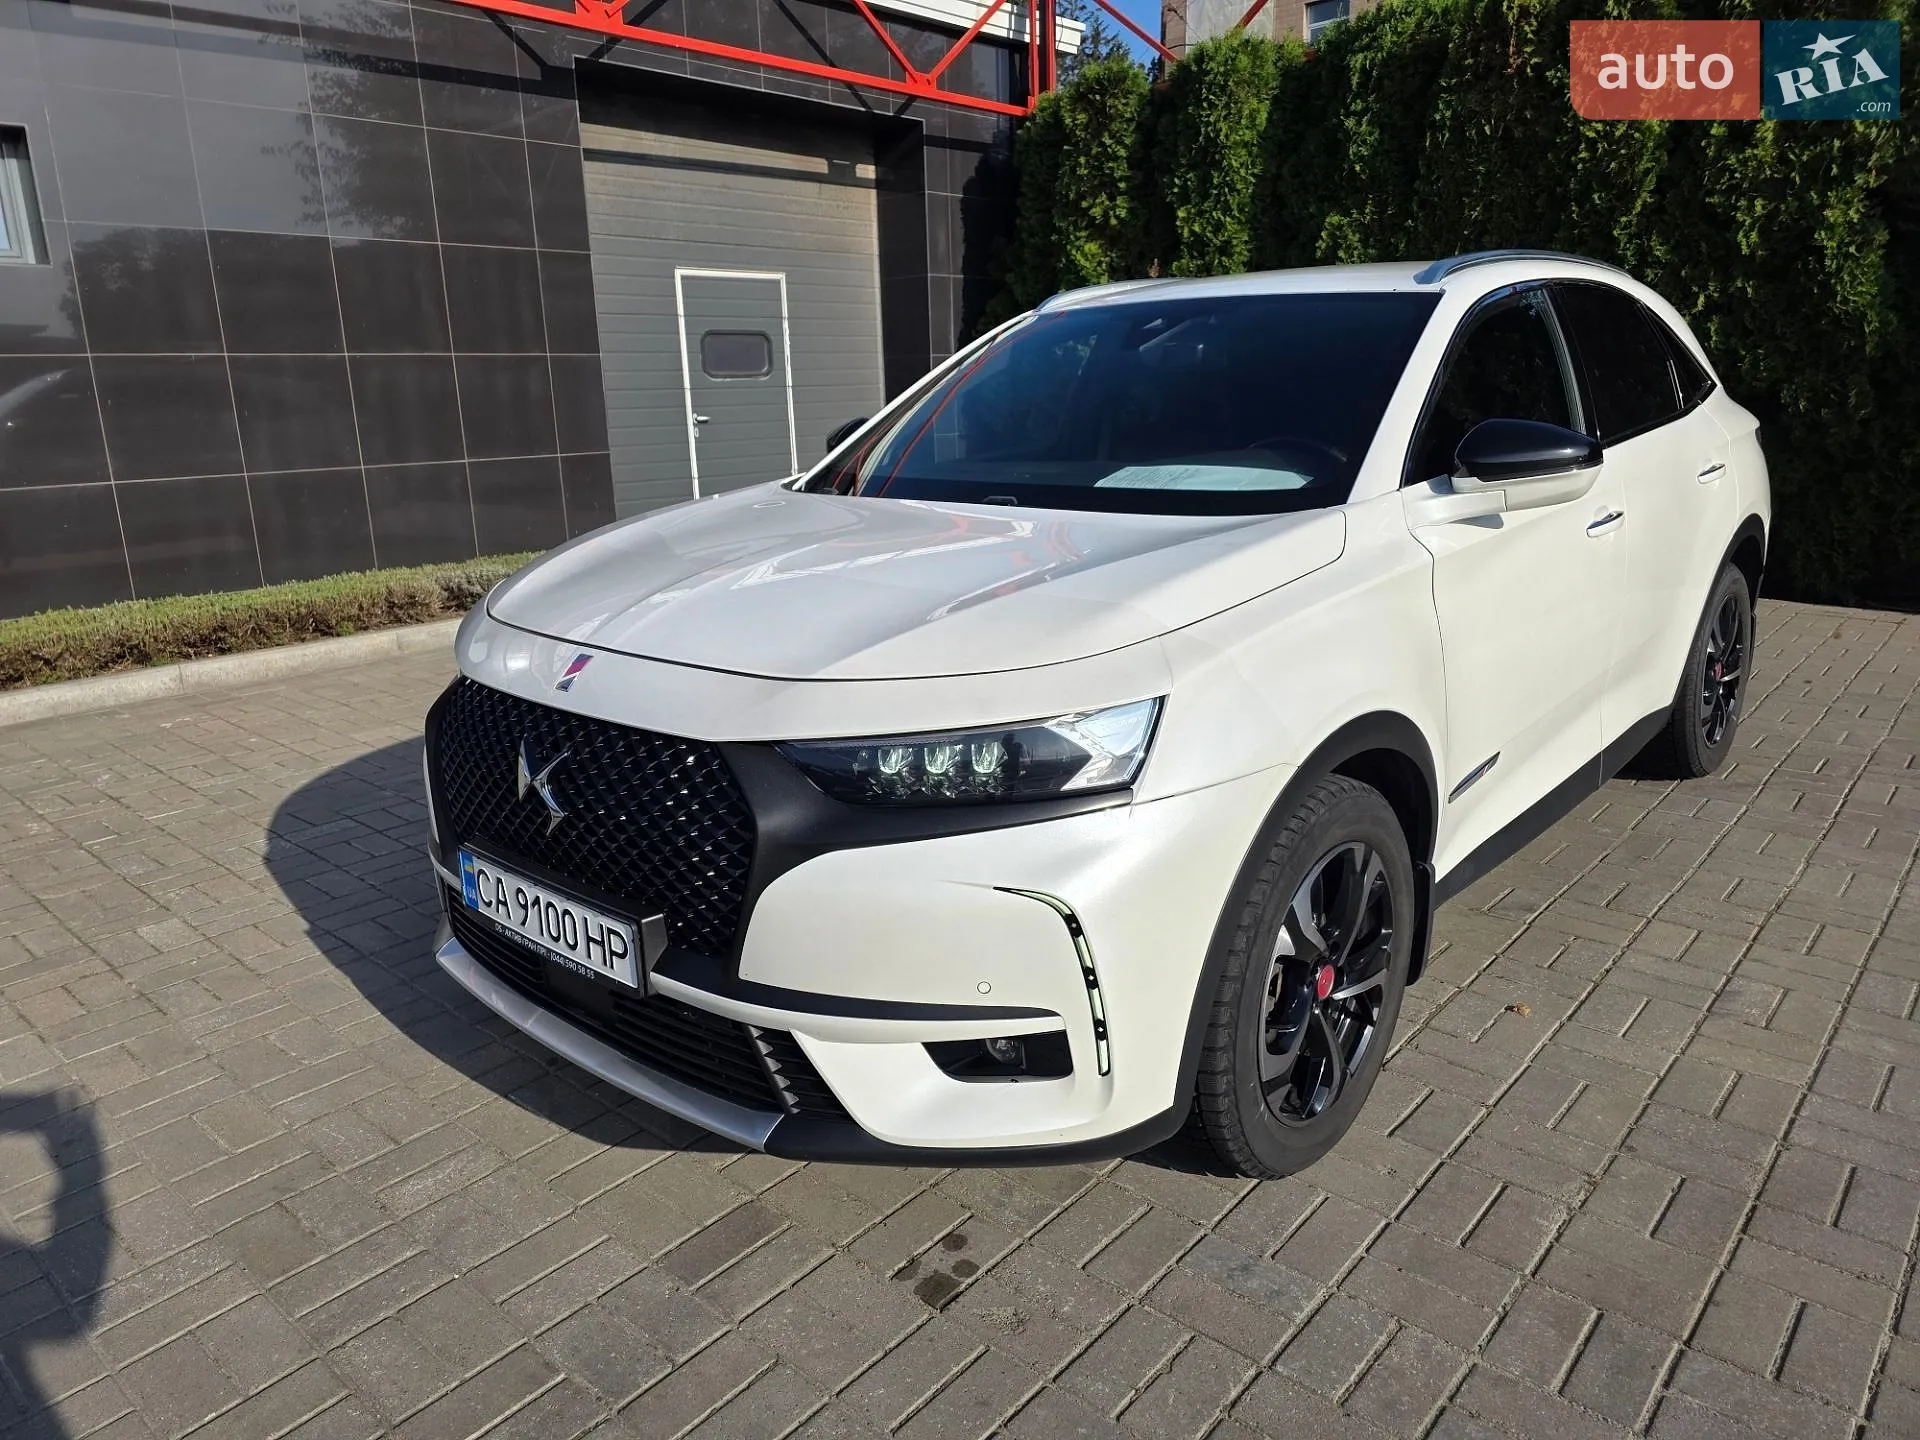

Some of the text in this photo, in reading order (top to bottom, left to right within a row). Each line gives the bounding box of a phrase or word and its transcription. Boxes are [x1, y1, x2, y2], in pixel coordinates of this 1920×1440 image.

[467, 886, 477, 900] UA
[477, 868, 630, 971] CA 9100 HP
[565, 959, 577, 971] 590
[577, 965, 586, 976] 58
